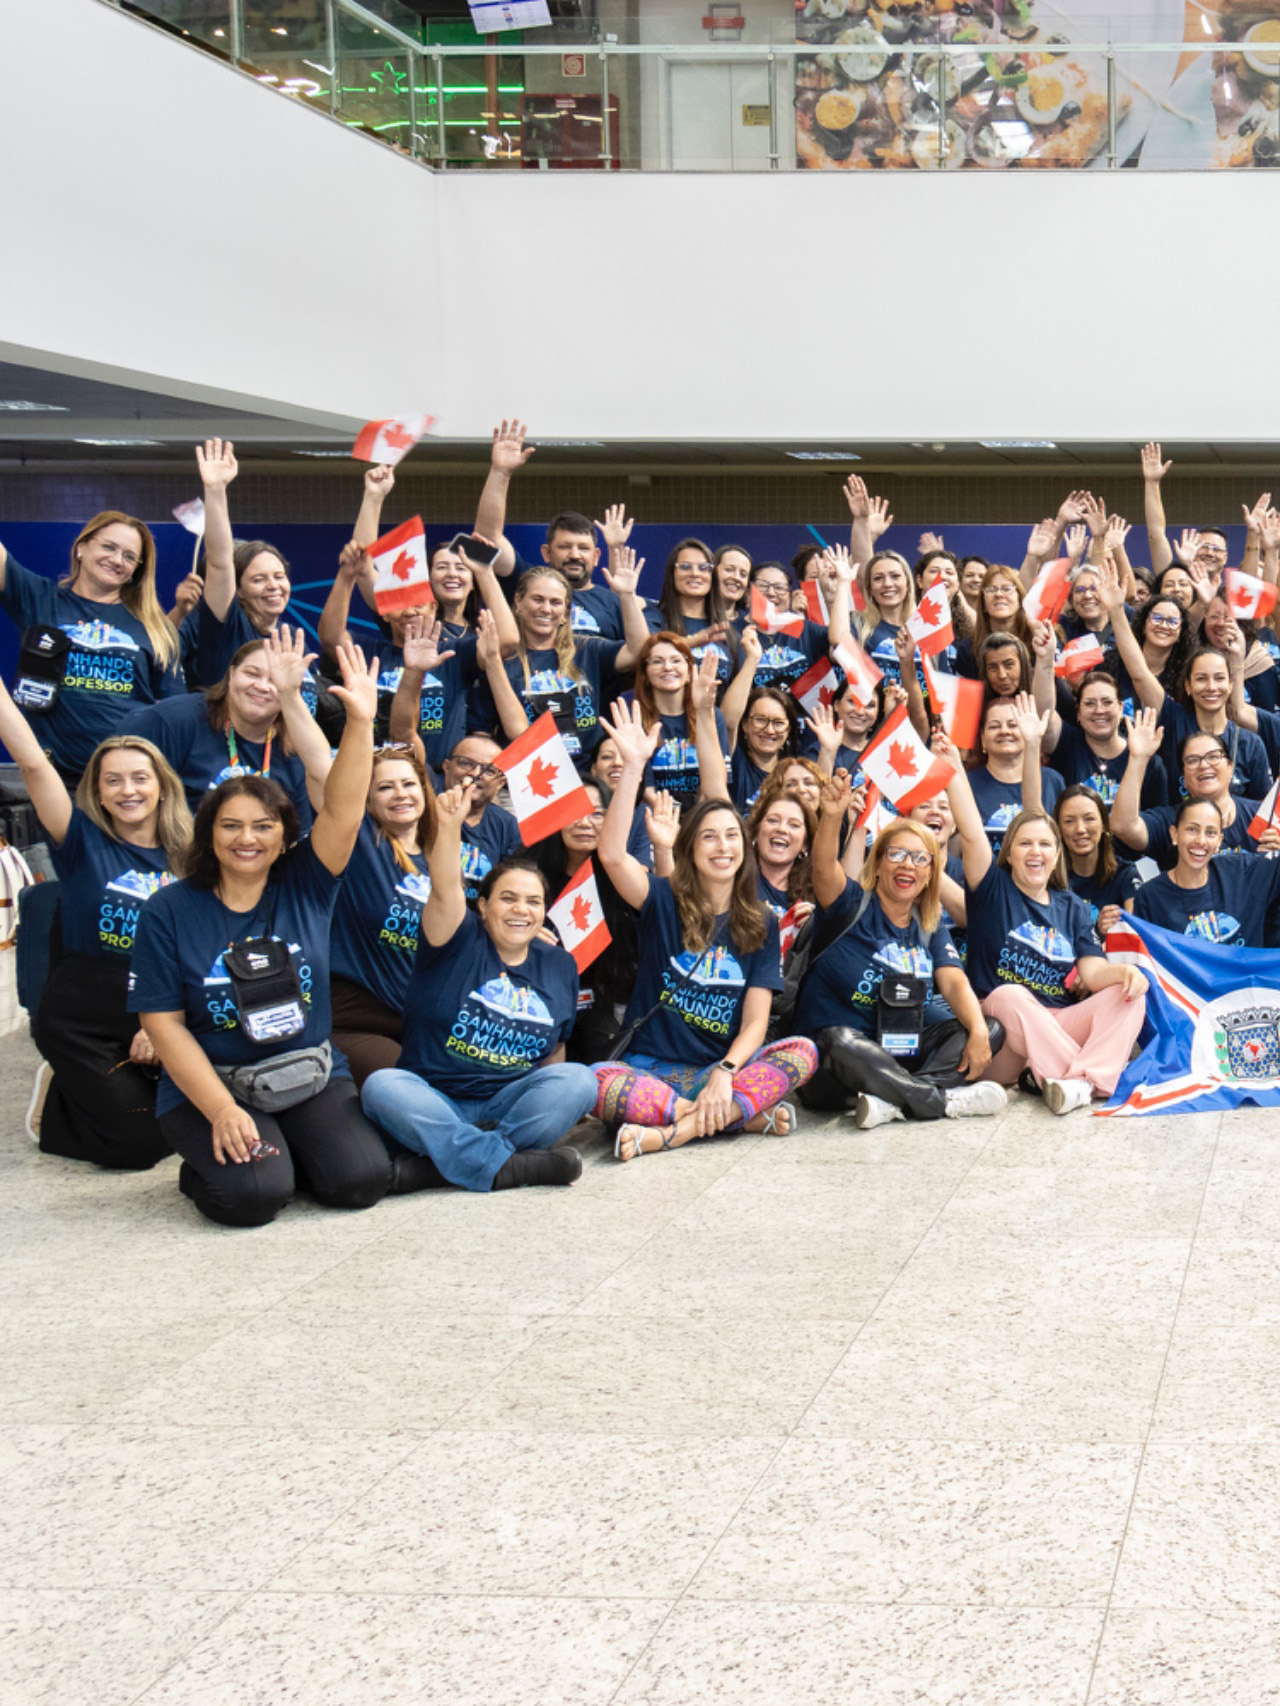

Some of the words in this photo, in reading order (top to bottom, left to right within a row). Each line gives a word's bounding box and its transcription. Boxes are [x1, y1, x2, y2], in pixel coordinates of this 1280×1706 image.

[68, 651, 134, 672] NHANDO
[64, 676, 134, 694] OFESSOR
[99, 917, 115, 932] O
[385, 916, 400, 930] O
[858, 980, 872, 994] O
[672, 993, 733, 1022] MUNDO
[457, 1010, 547, 1049] GANHANDO
[445, 1035, 533, 1067] PROFESS
